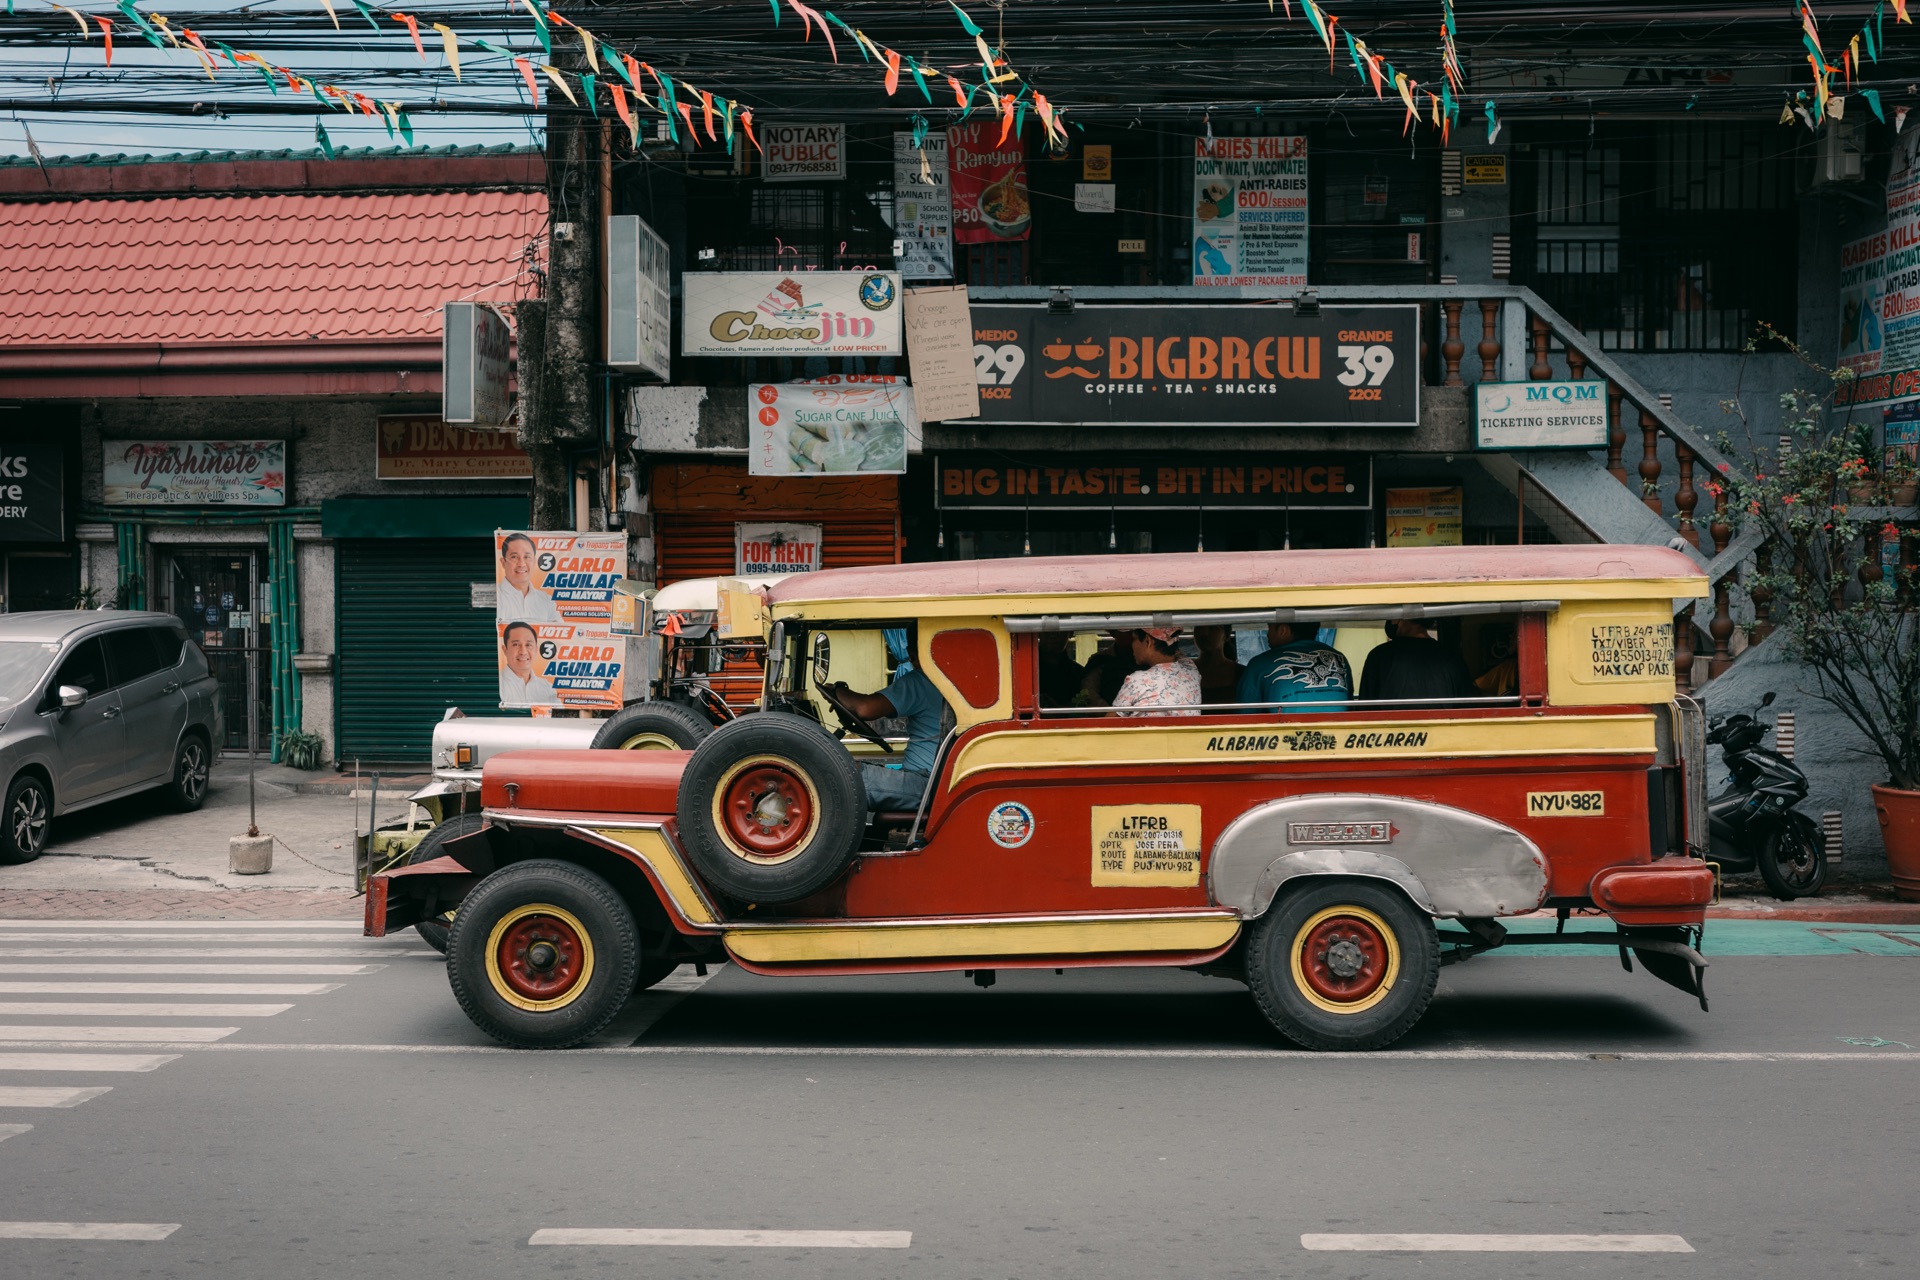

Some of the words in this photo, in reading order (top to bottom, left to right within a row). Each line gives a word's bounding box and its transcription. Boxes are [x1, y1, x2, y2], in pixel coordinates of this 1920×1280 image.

[767, 127, 840, 143] NOTARY
[947, 123, 981, 148] DIY
[769, 144, 838, 161] PUBLIC
[1258, 137, 1306, 158] KILLS!
[956, 148, 1022, 171] Ramyun
[1467, 157, 1503, 166] CAUTION
[769, 163, 838, 173] 09177968581
[1196, 161, 1222, 175] DON'T
[1253, 160, 1306, 176] VACCINATE!
[1240, 180, 1306, 190] ANTI-RABIES
[1240, 212, 1272, 222] SERVICES
[1275, 212, 1305, 222] OFFERED
[1271, 224, 1305, 233] Management
[1121, 242, 1142, 250] PULL
[1262, 240, 1274, 248] Post
[1275, 240, 1298, 248] Exposure
[1842, 234, 1886, 268] RABIES
[1195, 276, 1213, 286] AVAIL
[1215, 276, 1229, 286] OUR
[1231, 276, 1256, 286] LOWEST
[1258, 275, 1288, 286] PACKAGE
[1290, 275, 1306, 285] RATE
[975, 330, 1018, 342] MEDIO
[1337, 331, 1393, 342] GRANDE
[795, 345, 823, 353] products
[973, 344, 1025, 385] 29
[1109, 337, 1321, 380] BIGBREW
[1337, 345, 1395, 387] 39
[847, 374, 897, 384] OPEN
[1085, 385, 1145, 395] COFFEE
[1166, 385, 1194, 395] TEA
[1216, 384, 1278, 395] SNACKS
[1526, 386, 1599, 405] MQM
[1481, 418, 1543, 428] TICKETING
[1547, 416, 1603, 426] SERVICES
[394, 459, 415, 469] Dr.
[422, 459, 460, 472] Mary
[466, 457, 526, 468] Corvera
[944, 470, 999, 495] BIG
[1006, 469, 1038, 495] IN
[1044, 468, 1150, 495] TASTE.
[1157, 467, 1206, 493] BIT
[1213, 467, 1247, 492] IN
[1252, 466, 1353, 492] PRICE.
[125, 490, 181, 503] Therapeutic
[184, 491, 191, 500] &
[198, 490, 239, 502] Wellness
[242, 491, 260, 503] Spa
[539, 538, 574, 551] VOTE
[742, 542, 771, 562] FOR
[776, 542, 815, 563] RENT
[543, 556, 555, 570] 3
[557, 557, 616, 573] CARLO
[542, 573, 623, 589] AGUILAR
[557, 591, 571, 599] FOR
[572, 590, 608, 600] MAYOR
[539, 627, 572, 640] VOTE
[1592, 626, 1630, 638] LTFRB
[1633, 627, 1652, 637] 24/7
[545, 645, 555, 658] 3
[557, 645, 615, 661] CARLO
[543, 661, 622, 679] AGUILAR
[1594, 665, 1620, 676] MAX
[1624, 663, 1645, 675] CAP
[1649, 663, 1669, 675] PASS
[557, 679, 571, 687] FOR
[571, 679, 606, 689] MAYOR
[1207, 736, 1278, 751] ALABANG
[1344, 732, 1428, 749] BACLARAN
[1290, 741, 1337, 751] ZAPOTE
[1122, 816, 1167, 830] LTFRB
[1108, 831, 1128, 839] CASE
[1294, 825, 1384, 840] WELING
[1101, 841, 1122, 849] OPTR
[1135, 841, 1154, 849] JOSE
[1101, 851, 1126, 859] ROUTE
[1102, 860, 1123, 870] TYPE
